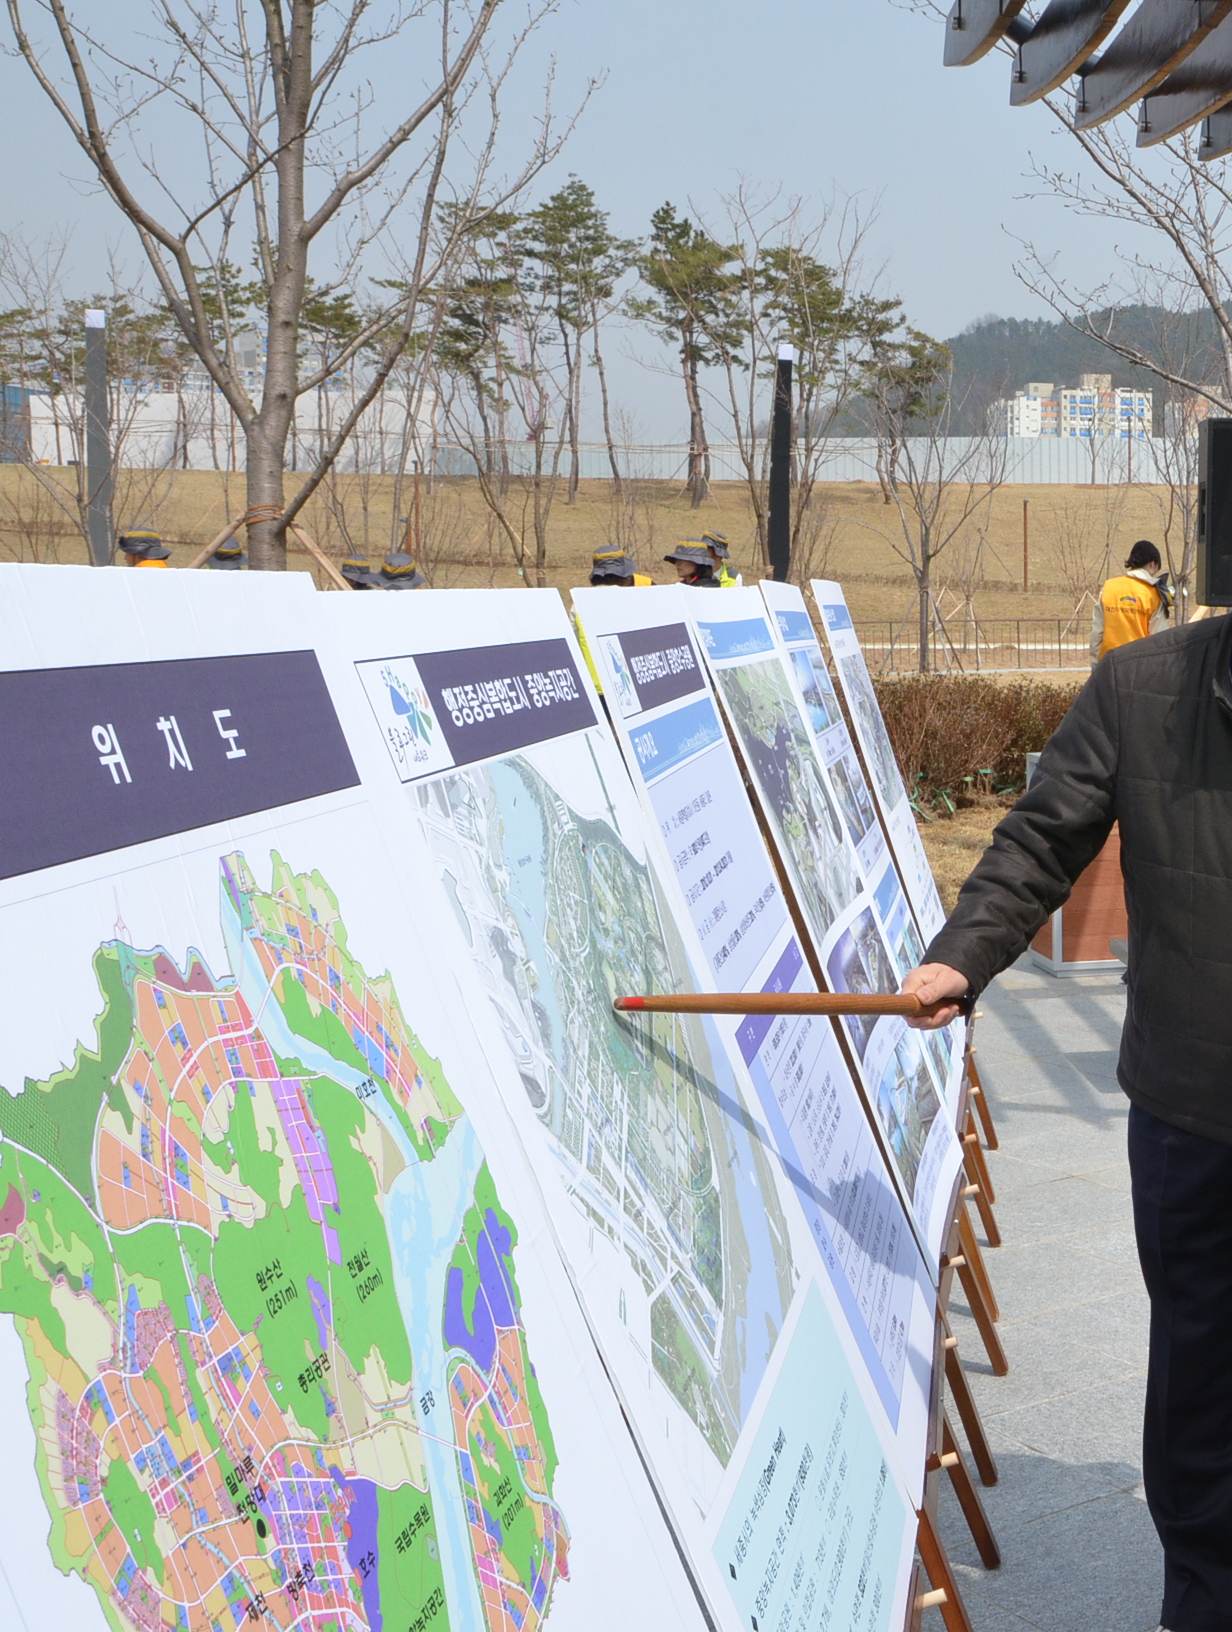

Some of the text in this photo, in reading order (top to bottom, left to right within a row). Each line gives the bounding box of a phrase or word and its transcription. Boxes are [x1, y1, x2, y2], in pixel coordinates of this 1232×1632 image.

[441, 676, 531, 727] 행정중심복합도시
[525, 667, 580, 709] 중앙녹지공간
[92, 709, 247, 784] 위 치 도
[355, 1074, 377, 1100] 미호천
[256, 1258, 283, 1292] 원수산
[346, 1248, 370, 1279] 전월산
[266, 1279, 298, 1319] (251m)
[356, 1267, 384, 1303] (260m)
[297, 1351, 331, 1394] 총리공관
[420, 1389, 435, 1416] 금강
[225, 1455, 257, 1496] 밀마루
[236, 1484, 266, 1524] 전망대
[502, 1492, 524, 1531] (201m)
[395, 1503, 431, 1555] 국립수목원
[287, 1560, 315, 1601] 방축천
[359, 1551, 376, 1579] 호수
[755, 1549, 780, 1619] 중앙녹지공간
